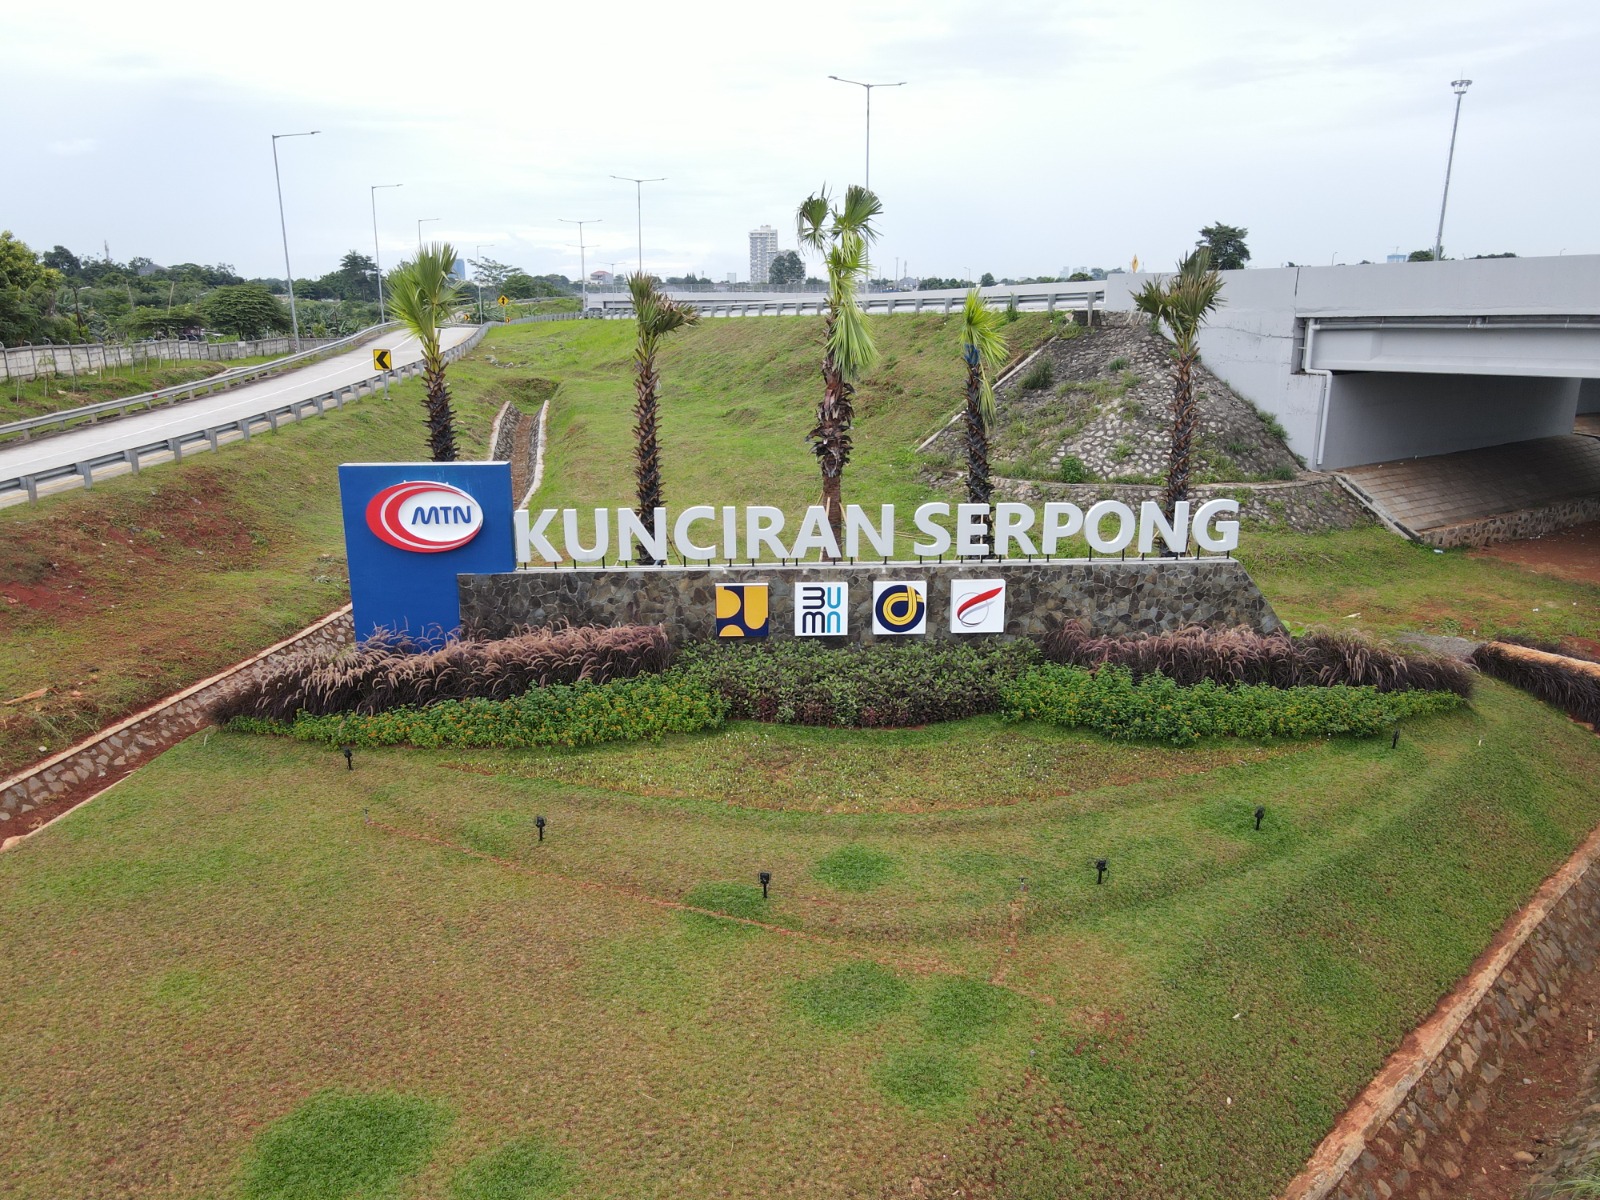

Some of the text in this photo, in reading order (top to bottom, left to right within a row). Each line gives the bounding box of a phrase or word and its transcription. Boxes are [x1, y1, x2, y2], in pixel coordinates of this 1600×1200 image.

[411, 505, 472, 526] MTN
[516, 498, 1240, 563] KUNCIRAN SERPONG
